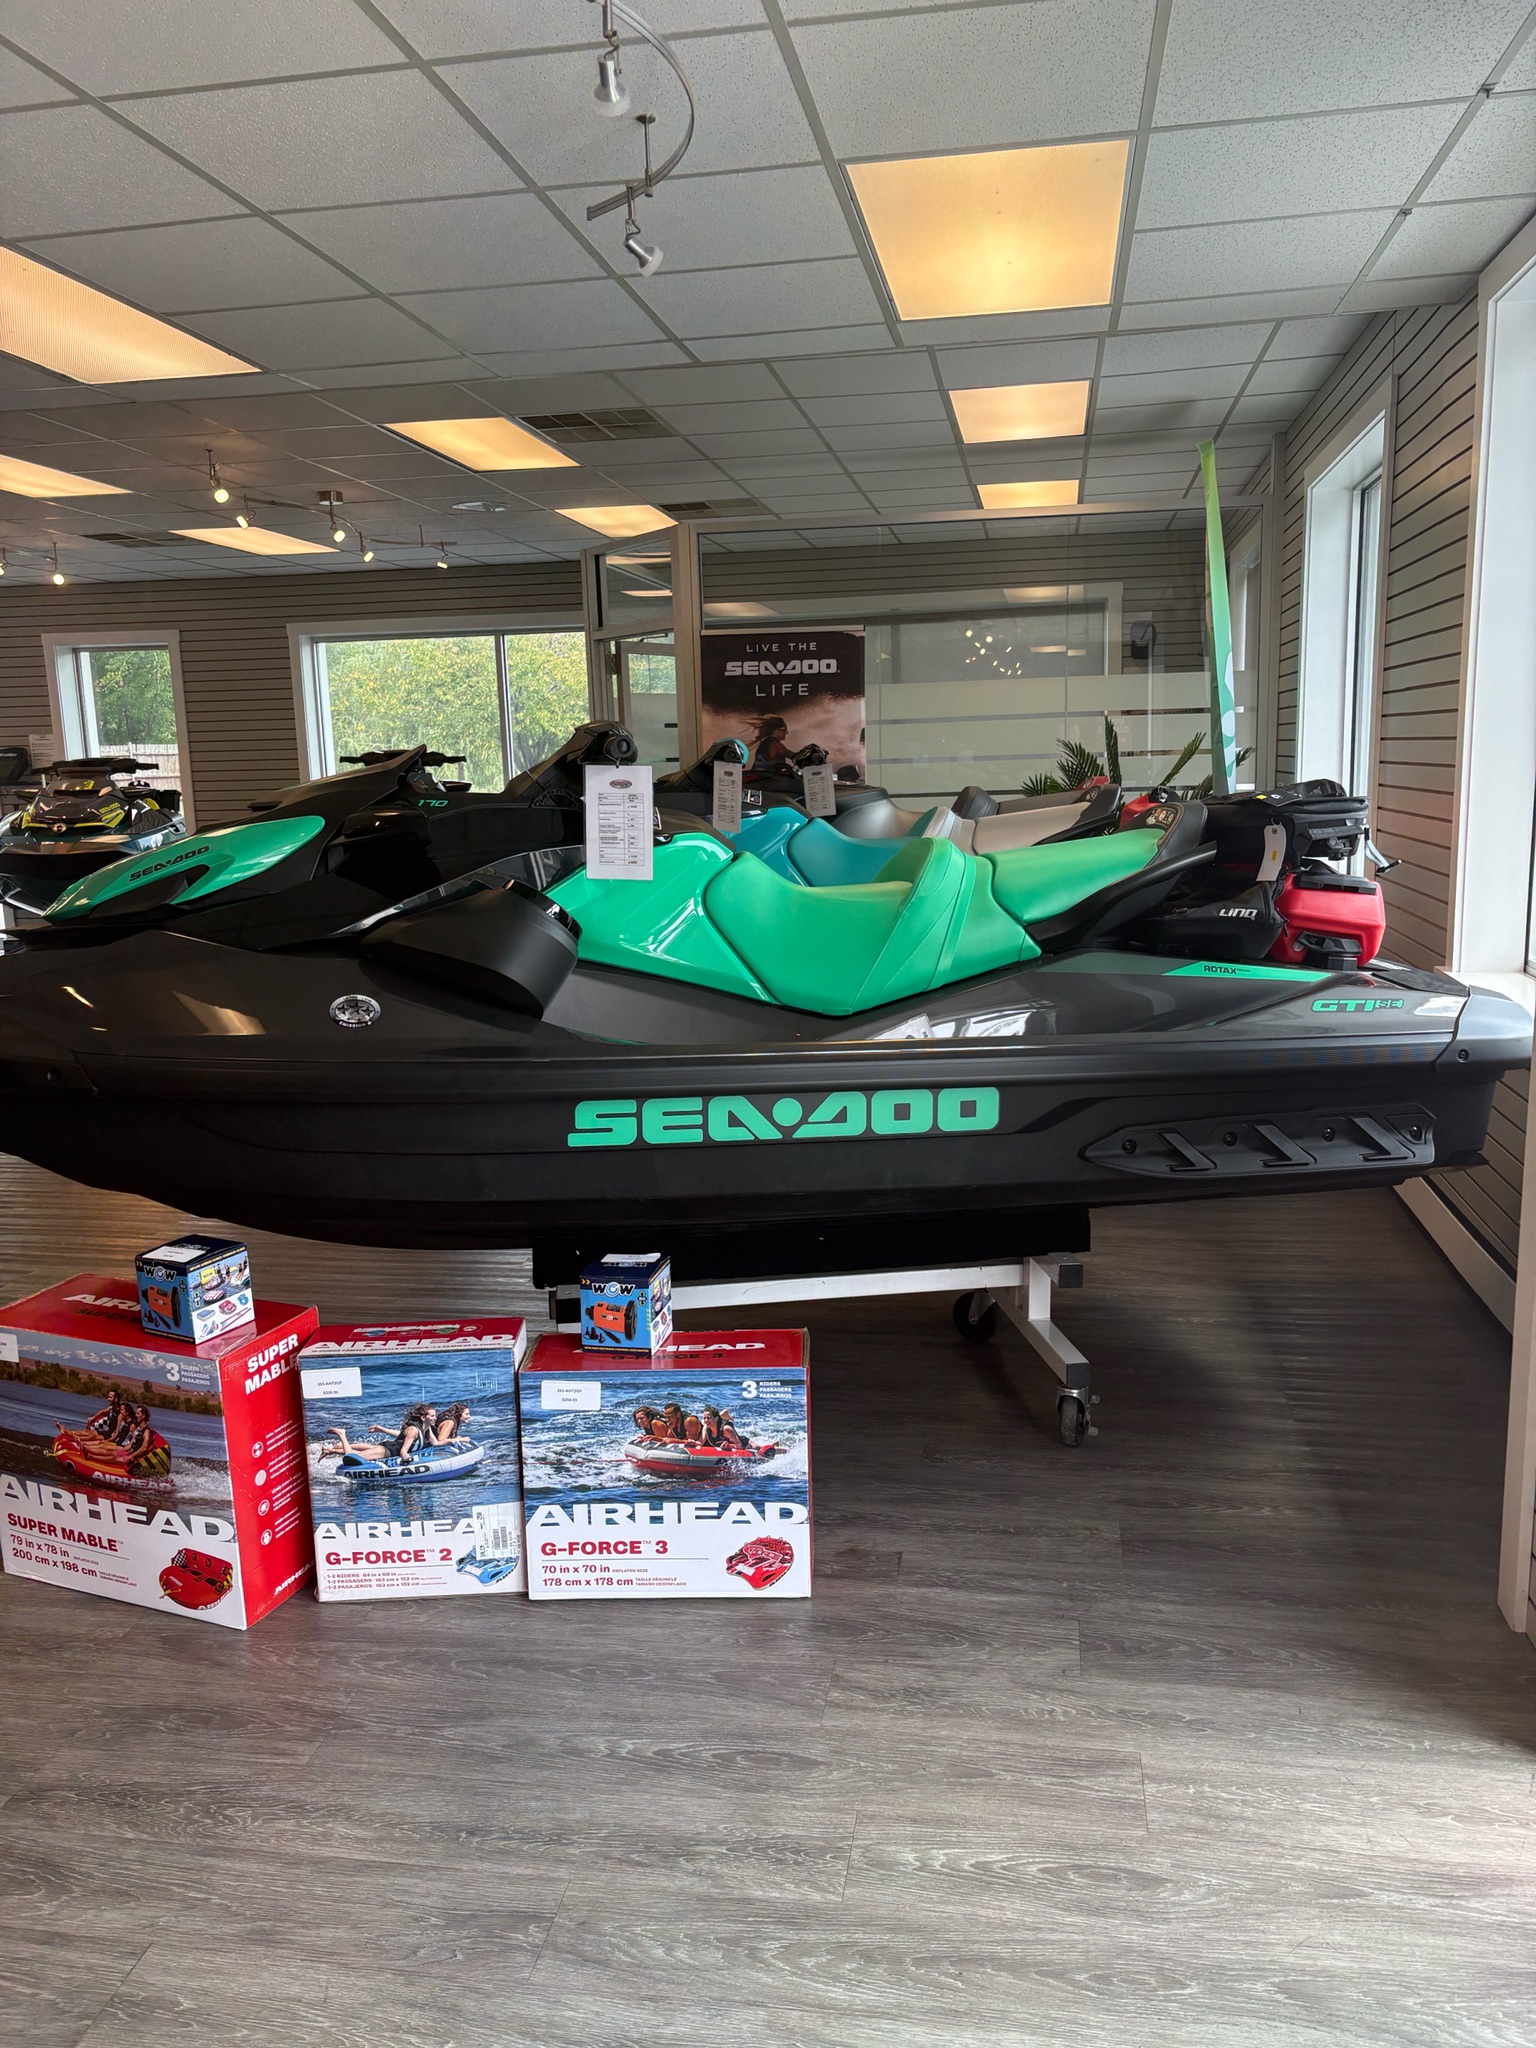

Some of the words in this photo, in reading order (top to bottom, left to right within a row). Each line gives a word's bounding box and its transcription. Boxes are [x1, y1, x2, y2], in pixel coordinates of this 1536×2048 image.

[746, 644, 780, 652] LIVE
[788, 642, 817, 651] THE
[756, 684, 809, 696] LIFE
[1204, 965, 1237, 975] ROTAX
[1312, 999, 1375, 1012] GTI
[144, 1266, 176, 1281] WOW
[592, 1282, 635, 1298] WOW
[302, 1334, 515, 1350] AIRHEAD
[247, 1332, 298, 1374] SUPER
[166, 1362, 180, 1382] 3
[742, 1380, 757, 1399] 3
[343, 1465, 430, 1479] AIRHEAD
[0, 1473, 235, 1542] AIRHEAD
[527, 1501, 808, 1526] AIRHEAD
[8, 1513, 58, 1537] SUPER
[314, 1518, 474, 1539] AIRHEA
[10, 1534, 22, 1546] 79
[25, 1538, 34, 1549] in
[36, 1543, 43, 1551] x
[44, 1543, 58, 1555] 78
[60, 1547, 69, 1558] in
[655, 1540, 668, 1554] 3
[12, 1547, 32, 1560] 200
[35, 1555, 50, 1566] cm
[52, 1559, 59, 1568] x
[61, 1560, 79, 1573] 198
[82, 1566, 97, 1578] cm
[439, 1548, 452, 1561] 2
[542, 1565, 556, 1574] 70
[560, 1565, 570, 1573] in
[582, 1564, 596, 1573] 70
[600, 1564, 610, 1572] in
[542, 1578, 562, 1587] 178
[594, 1577, 614, 1586] 178
[617, 1578, 633, 1586] cm
